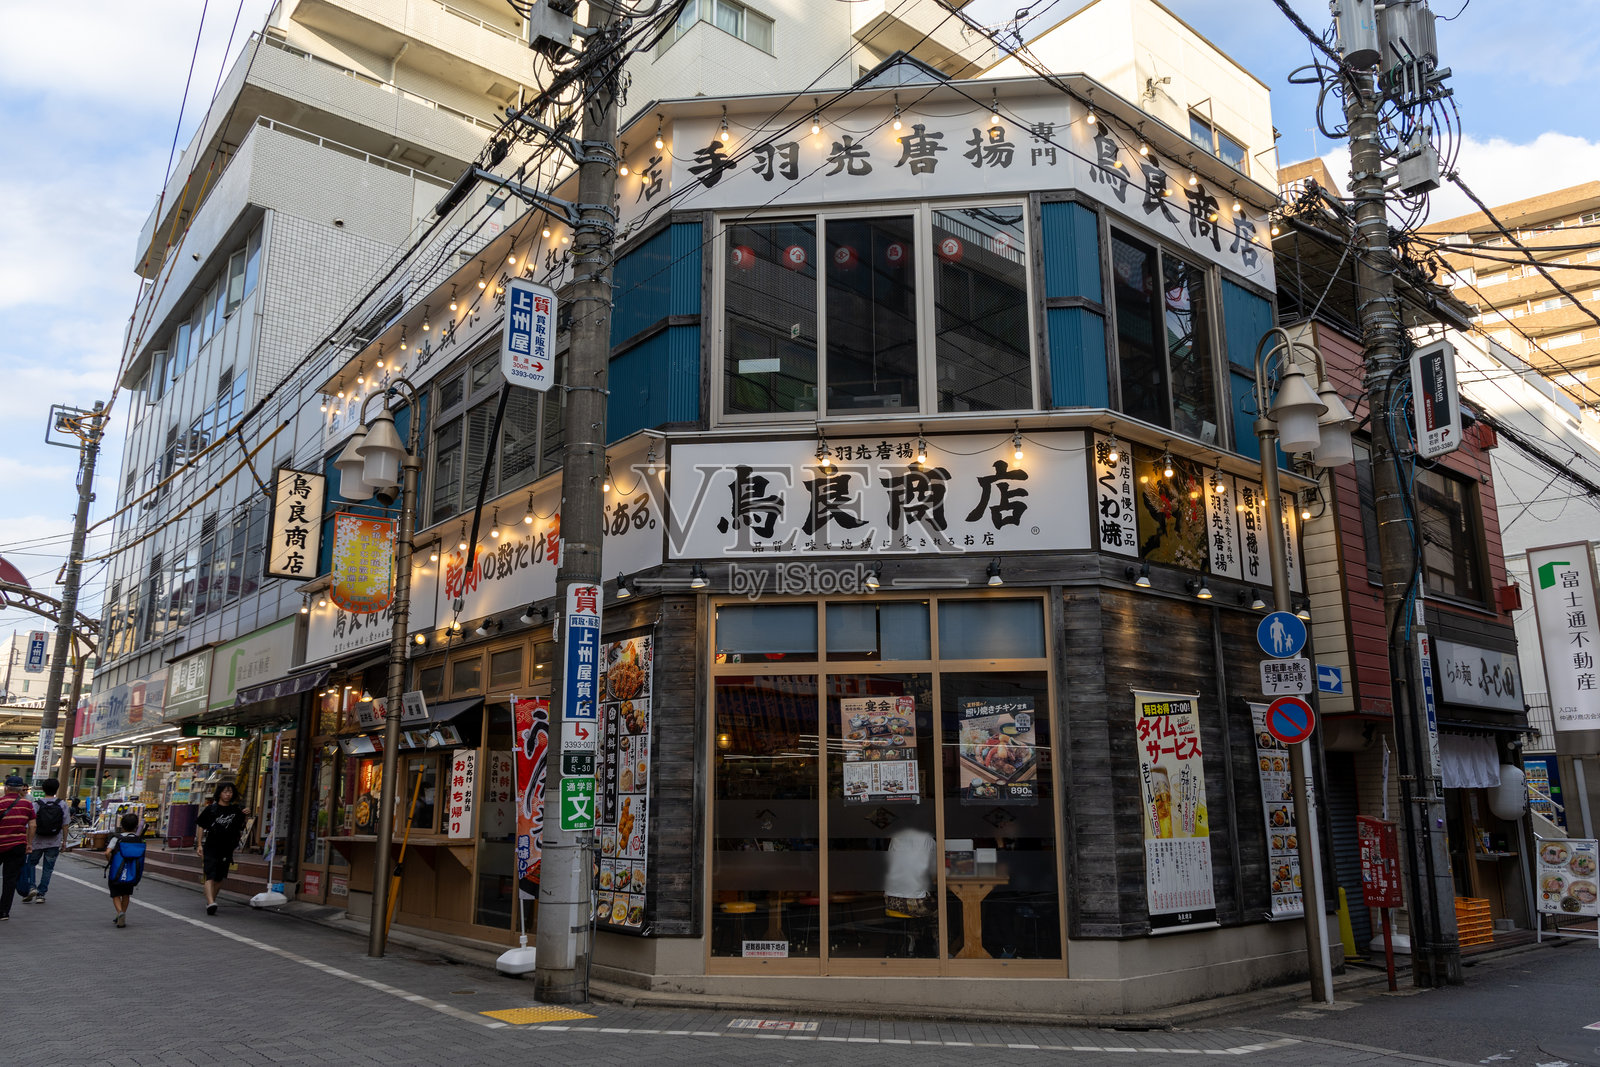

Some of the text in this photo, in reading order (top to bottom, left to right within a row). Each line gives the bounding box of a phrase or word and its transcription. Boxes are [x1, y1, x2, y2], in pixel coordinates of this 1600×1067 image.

[1089, 121, 1259, 269] 鳥良商店
[512, 291, 531, 352] 上州屋
[534, 297, 550, 316] 質
[511, 369, 545, 381] 3393-0077
[716, 460, 1030, 538] 鳥良商店
[1119, 450, 1136, 547] 商店自慢の一品
[282, 475, 312, 574] 鳥良商店
[444, 492, 656, 601] 乾杯の数だけ幸ある。
[574, 586, 599, 615] 質
[1560, 570, 1598, 691] 富士通不動産
[575, 629, 593, 717] 上州屋質店
[1264, 662, 1306, 673] 自転車を除く
[864, 700, 891, 712] 宴会
[1143, 702, 1170, 716] 毎日お得
[1136, 715, 1177, 742] タイム
[1146, 736, 1203, 764] サービス
[464, 755, 474, 812] からあげ・お弁当
[570, 764, 591, 773] 5-30
[1142, 762, 1155, 804] 生ビール
[451, 760, 466, 834] お持ち帰り
[566, 782, 593, 792] 通学路
[567, 792, 592, 822] 文
